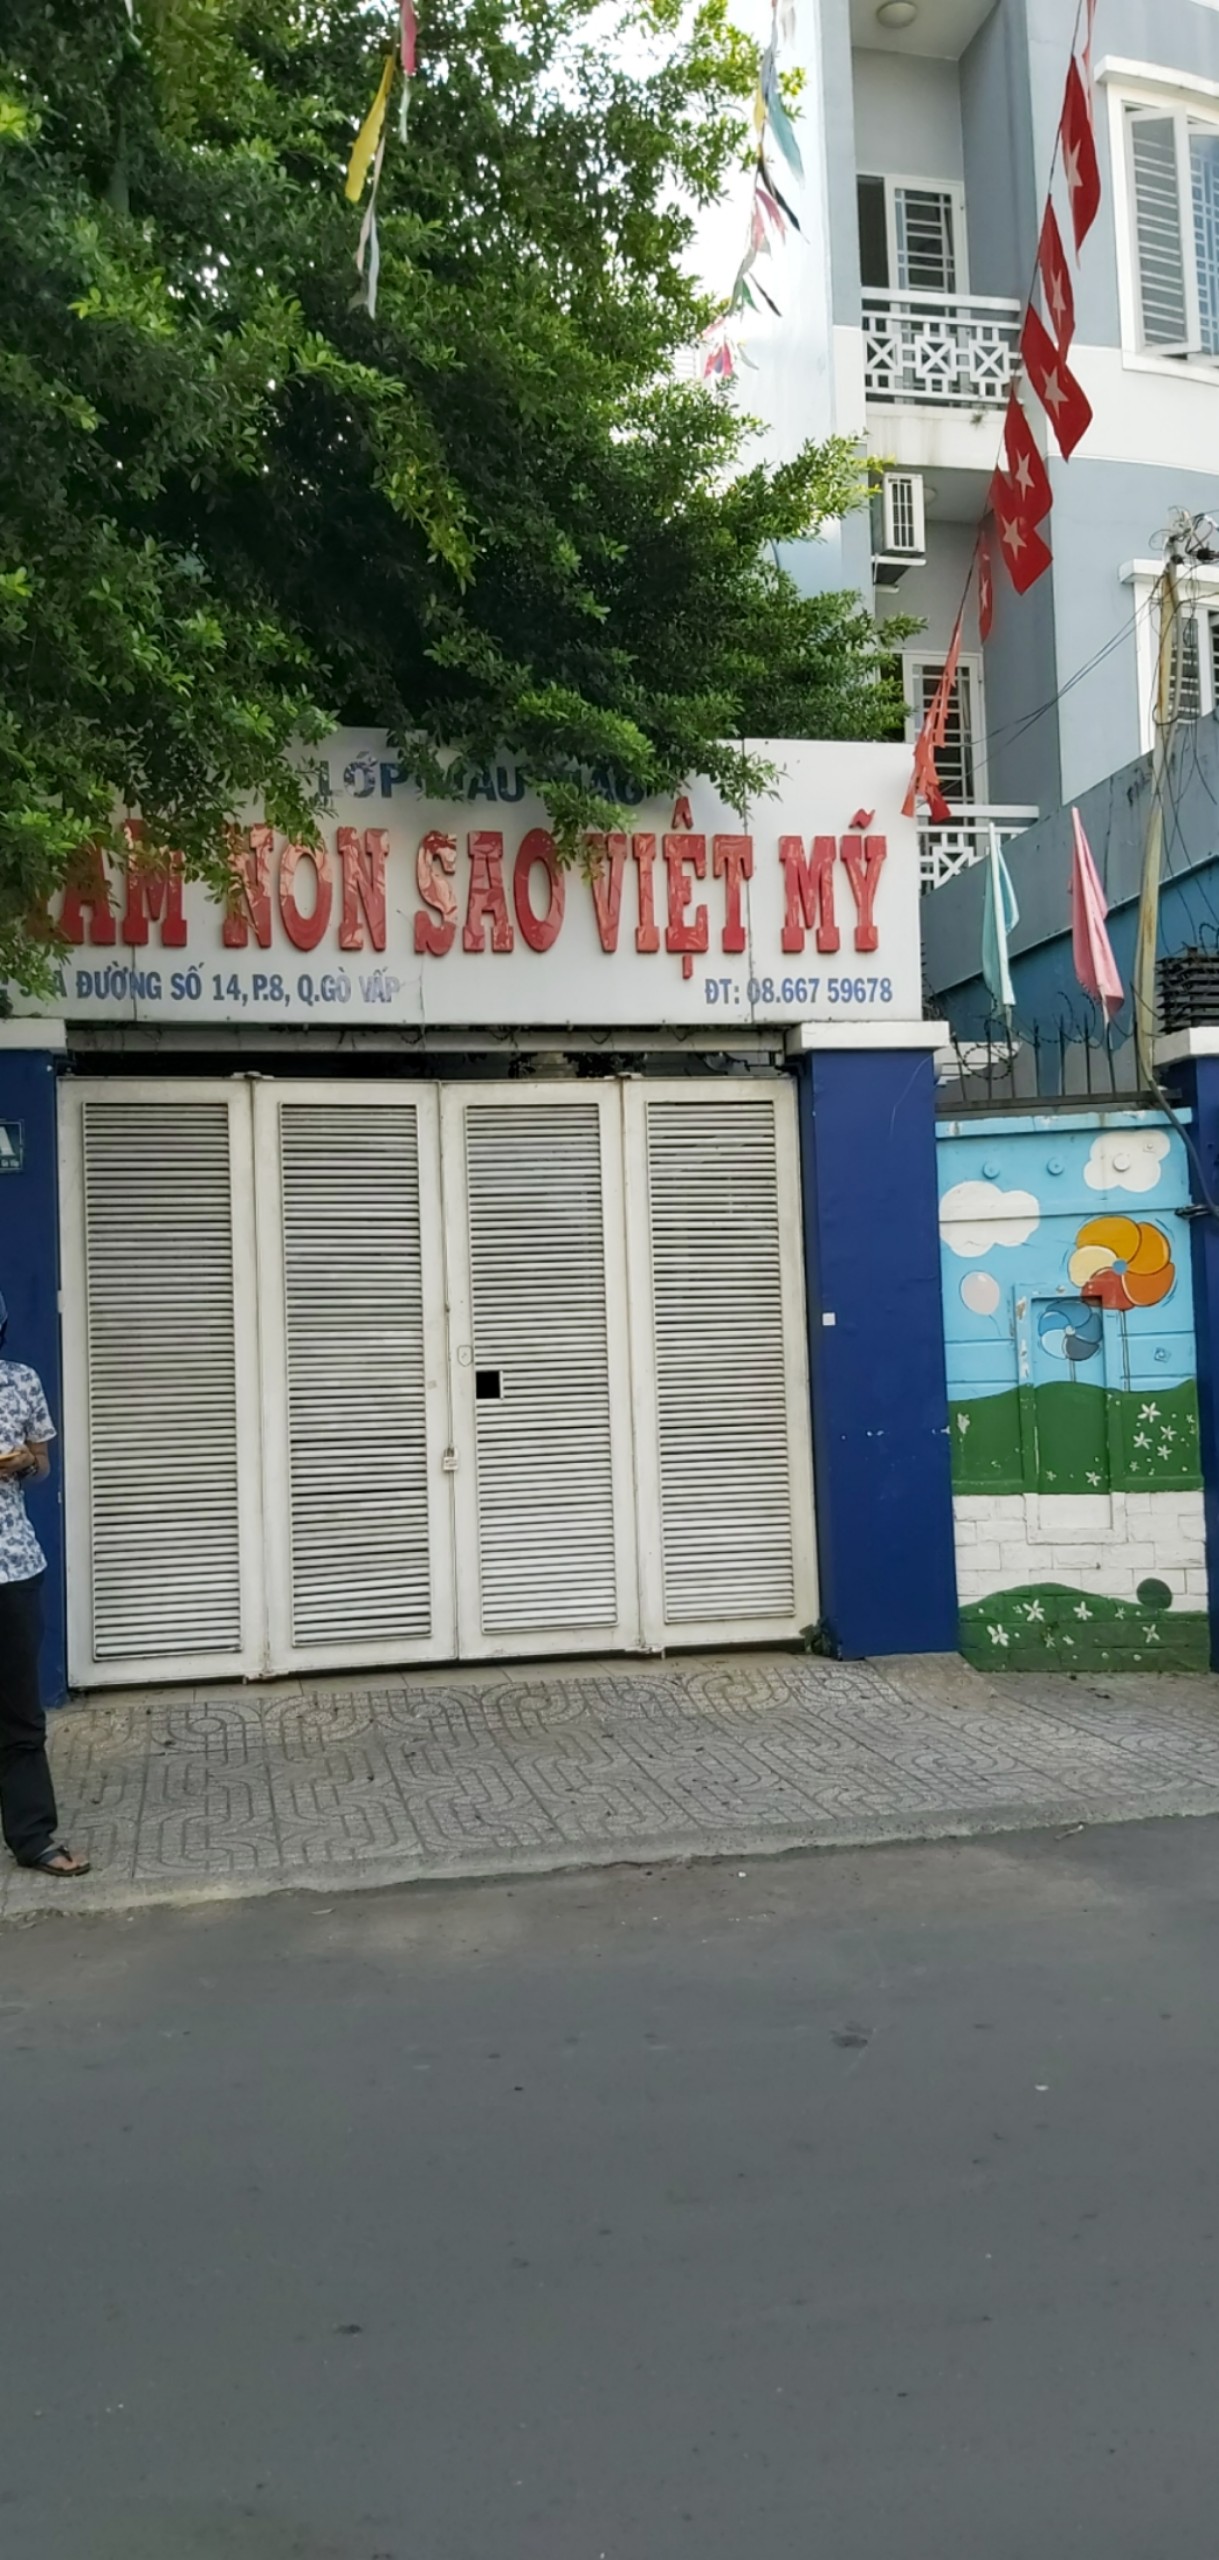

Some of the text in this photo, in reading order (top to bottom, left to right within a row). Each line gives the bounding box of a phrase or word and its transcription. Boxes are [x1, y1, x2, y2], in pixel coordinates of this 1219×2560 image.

[317, 751, 408, 798] LỚP
[223, 823, 390, 952] NON
[413, 828, 566, 957] SAO
[583, 796, 754, 979] VIỆT
[778, 808, 887, 953] MỸ
[76, 961, 162, 1001] ĐƯỜNG
[170, 962, 205, 1001] SỐ
[358, 966, 401, 1003] VẤP
[705, 977, 893, 1004] ĐT: 08.667 59678
